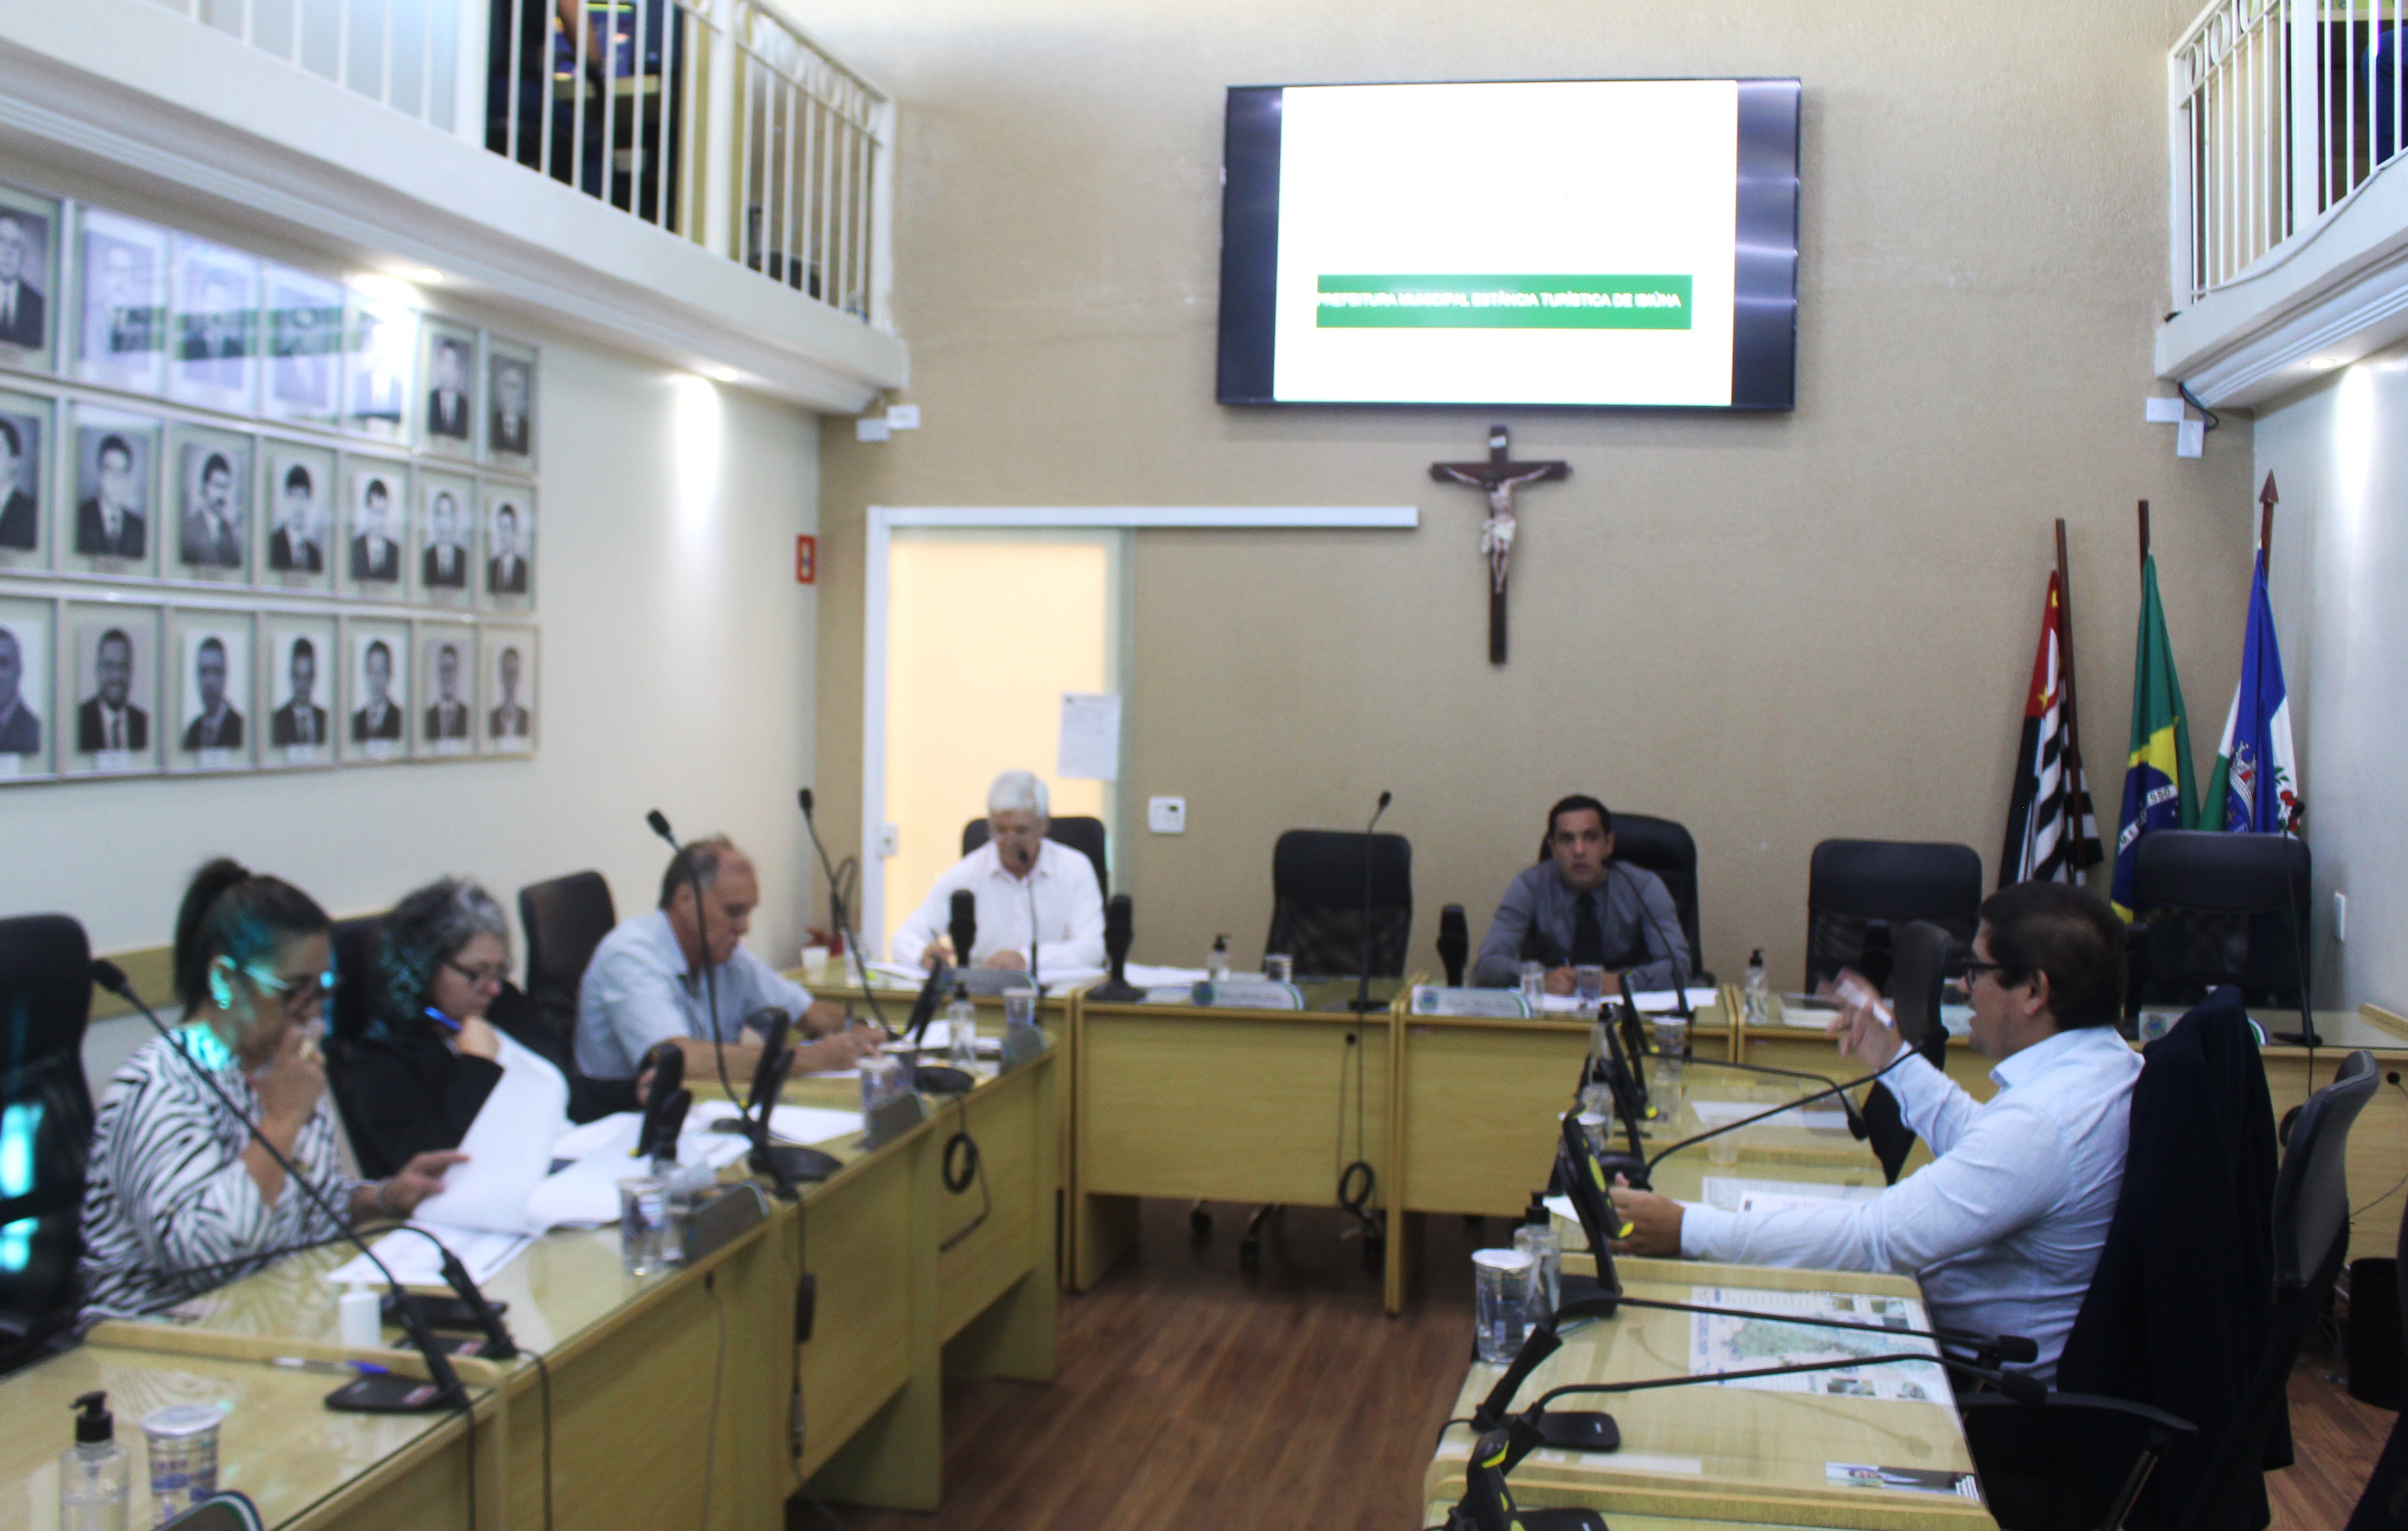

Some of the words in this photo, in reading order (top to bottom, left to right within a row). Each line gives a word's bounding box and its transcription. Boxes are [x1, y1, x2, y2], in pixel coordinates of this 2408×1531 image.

[1317, 292, 1397, 307] PREFEITURA
[1398, 292, 1470, 307] MUNICIPAL
[1472, 290, 1539, 307] ESTÂNCIA
[1541, 291, 1611, 307] TURÍSTICA
[1613, 292, 1633, 307] DE
